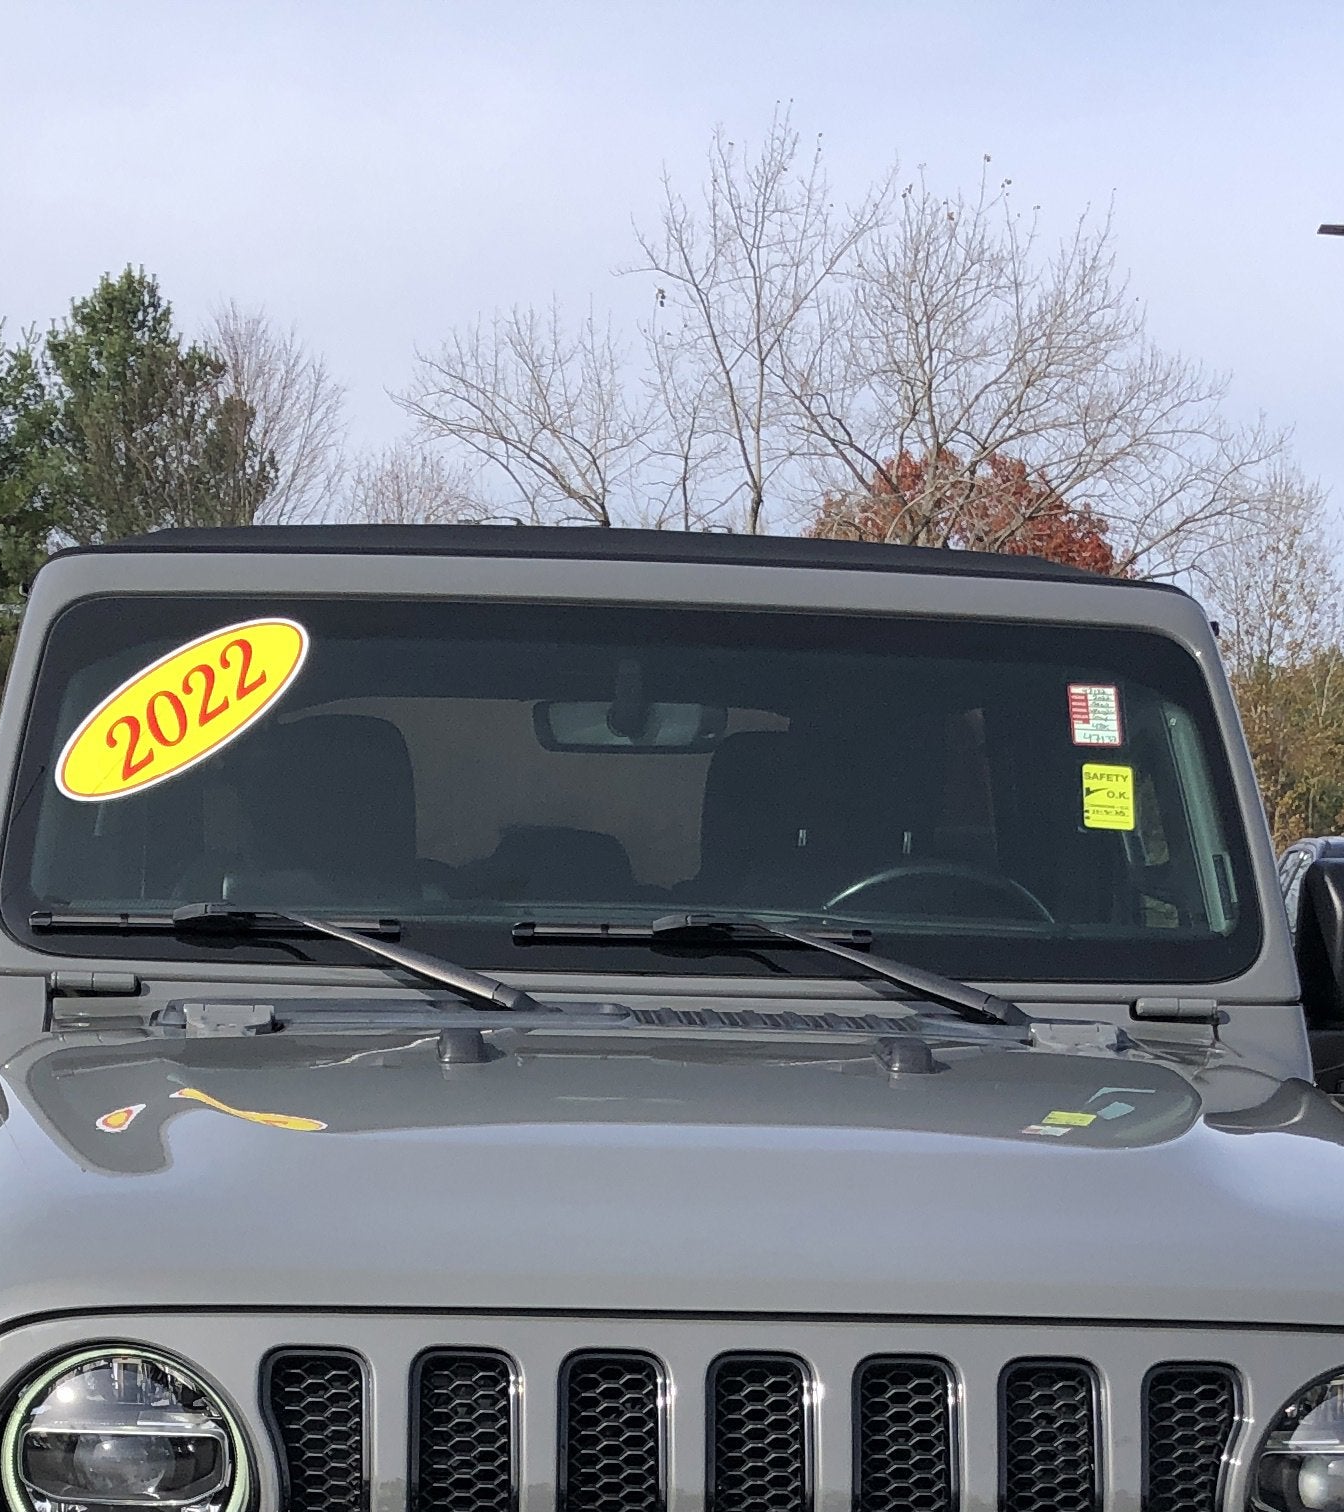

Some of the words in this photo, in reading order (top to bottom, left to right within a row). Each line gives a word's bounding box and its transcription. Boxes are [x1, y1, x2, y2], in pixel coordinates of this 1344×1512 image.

[106, 638, 267, 781] 2022
[1084, 771, 1129, 783] SAFETY
[1106, 789, 1130, 800] O.K.
